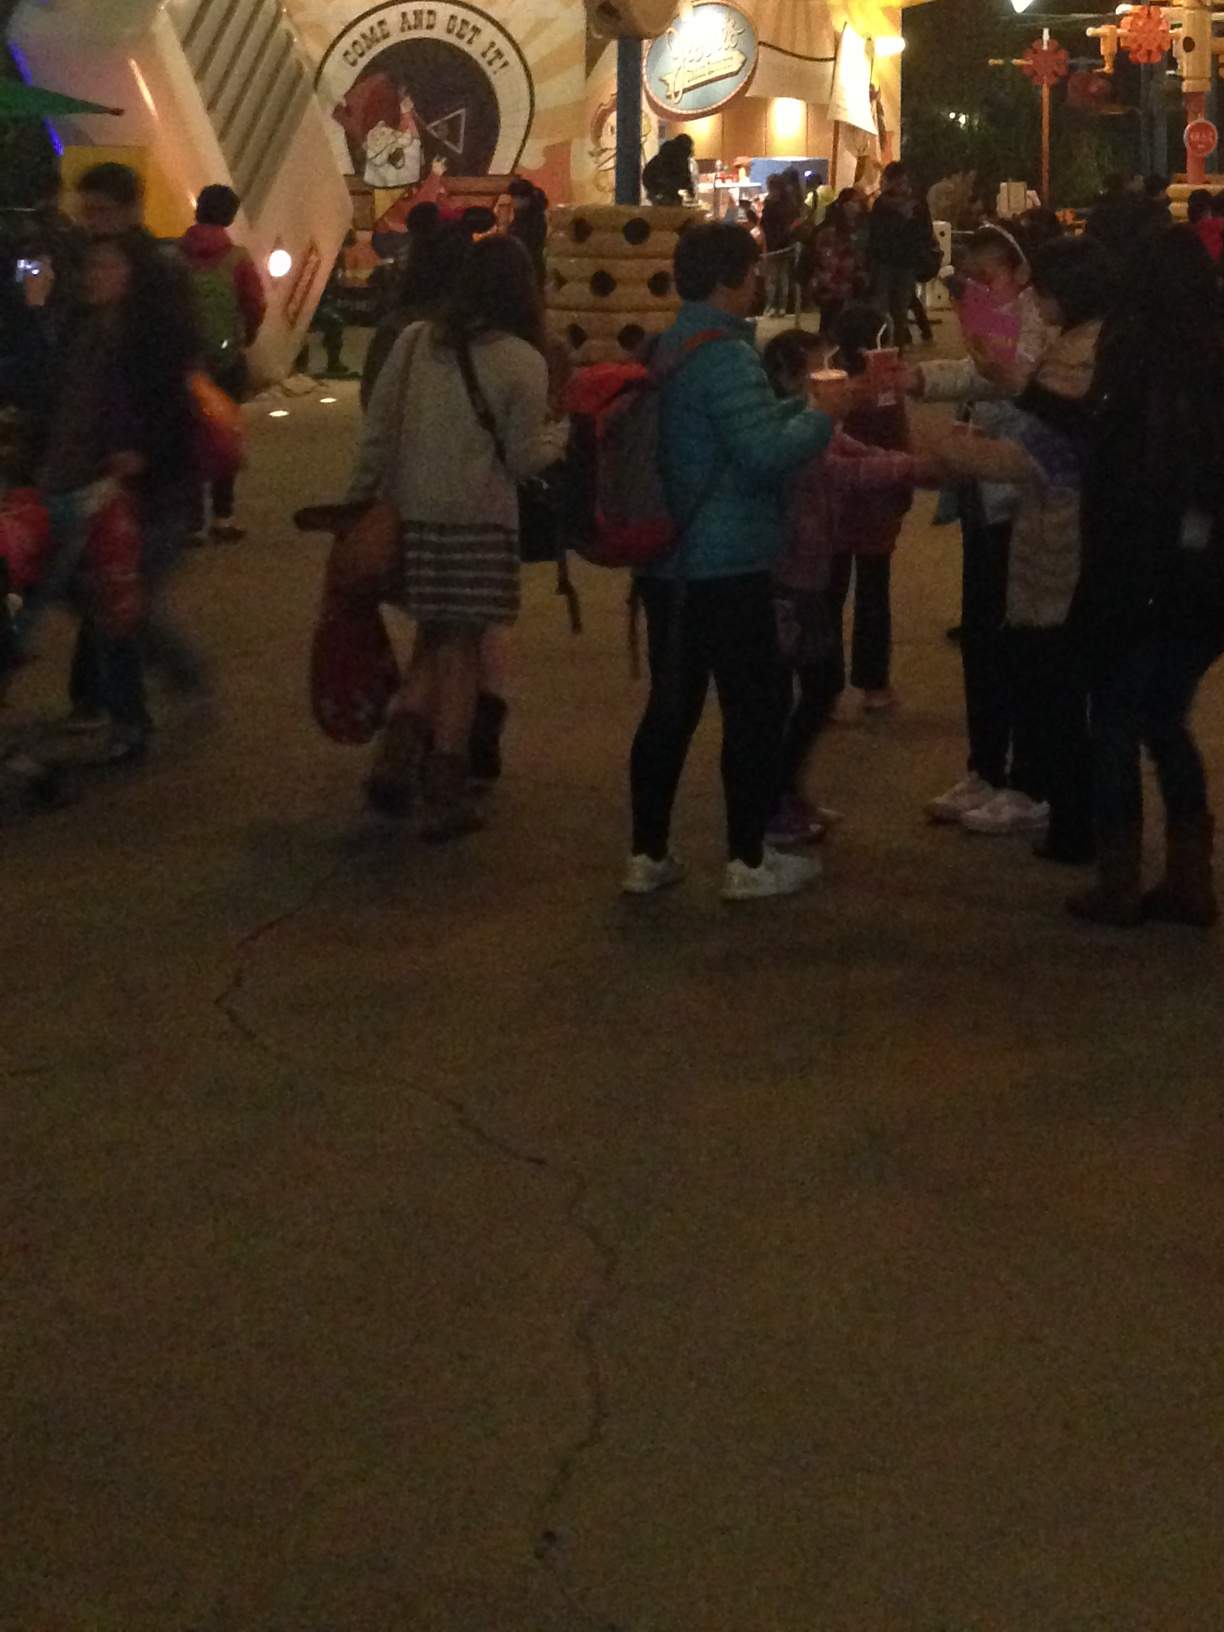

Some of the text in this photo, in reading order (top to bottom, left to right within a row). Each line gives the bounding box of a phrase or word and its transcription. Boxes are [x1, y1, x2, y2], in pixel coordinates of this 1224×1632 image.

[342, 9, 510, 75] COME AND GET IT!
